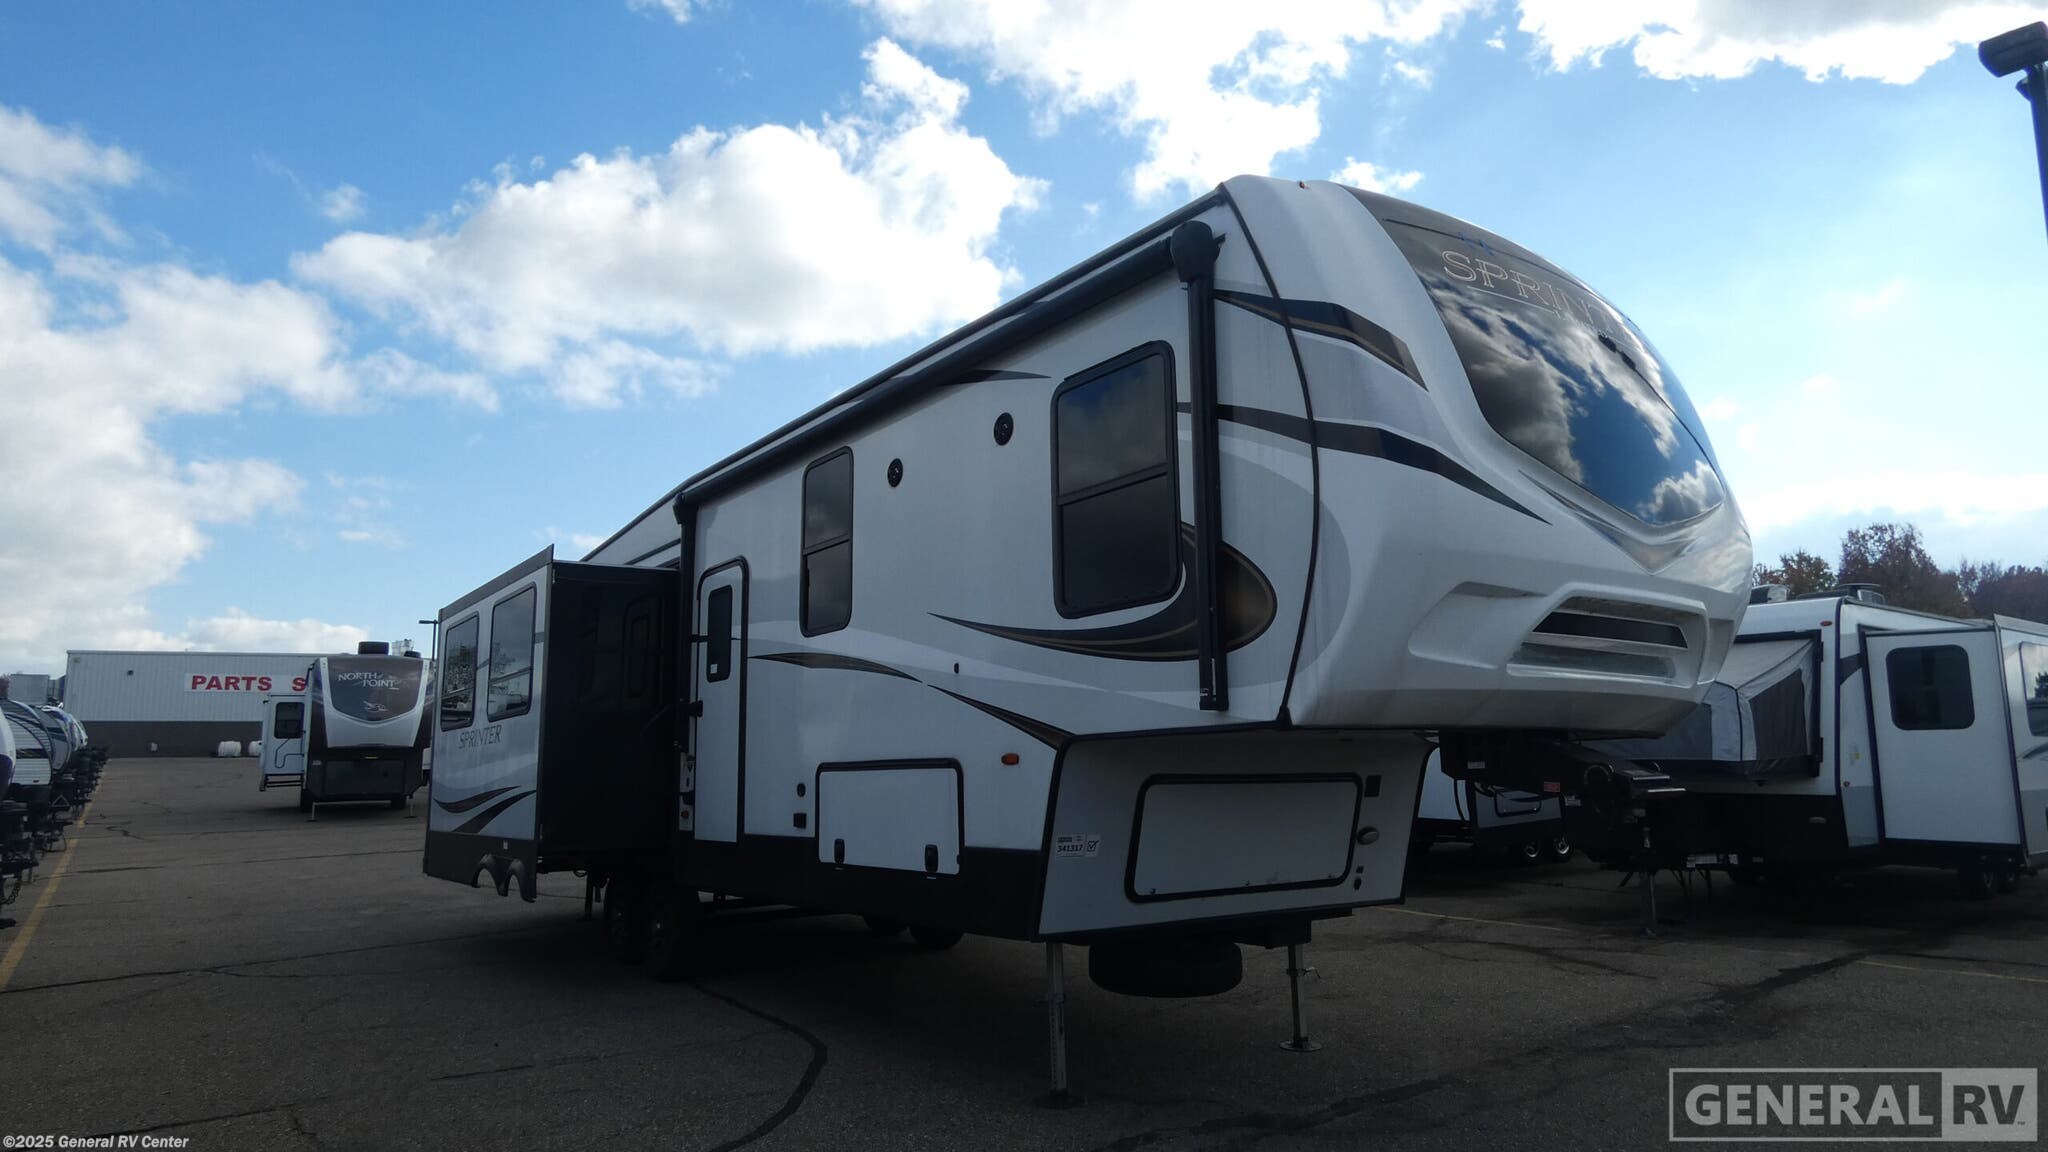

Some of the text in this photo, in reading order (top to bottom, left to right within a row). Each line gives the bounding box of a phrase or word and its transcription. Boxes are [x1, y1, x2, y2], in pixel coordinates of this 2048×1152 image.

[338, 672, 378, 681] NORTH
[191, 675, 273, 692] PARTS
[362, 679, 396, 688] POINT
[459, 725, 502, 749] SPRINTER
